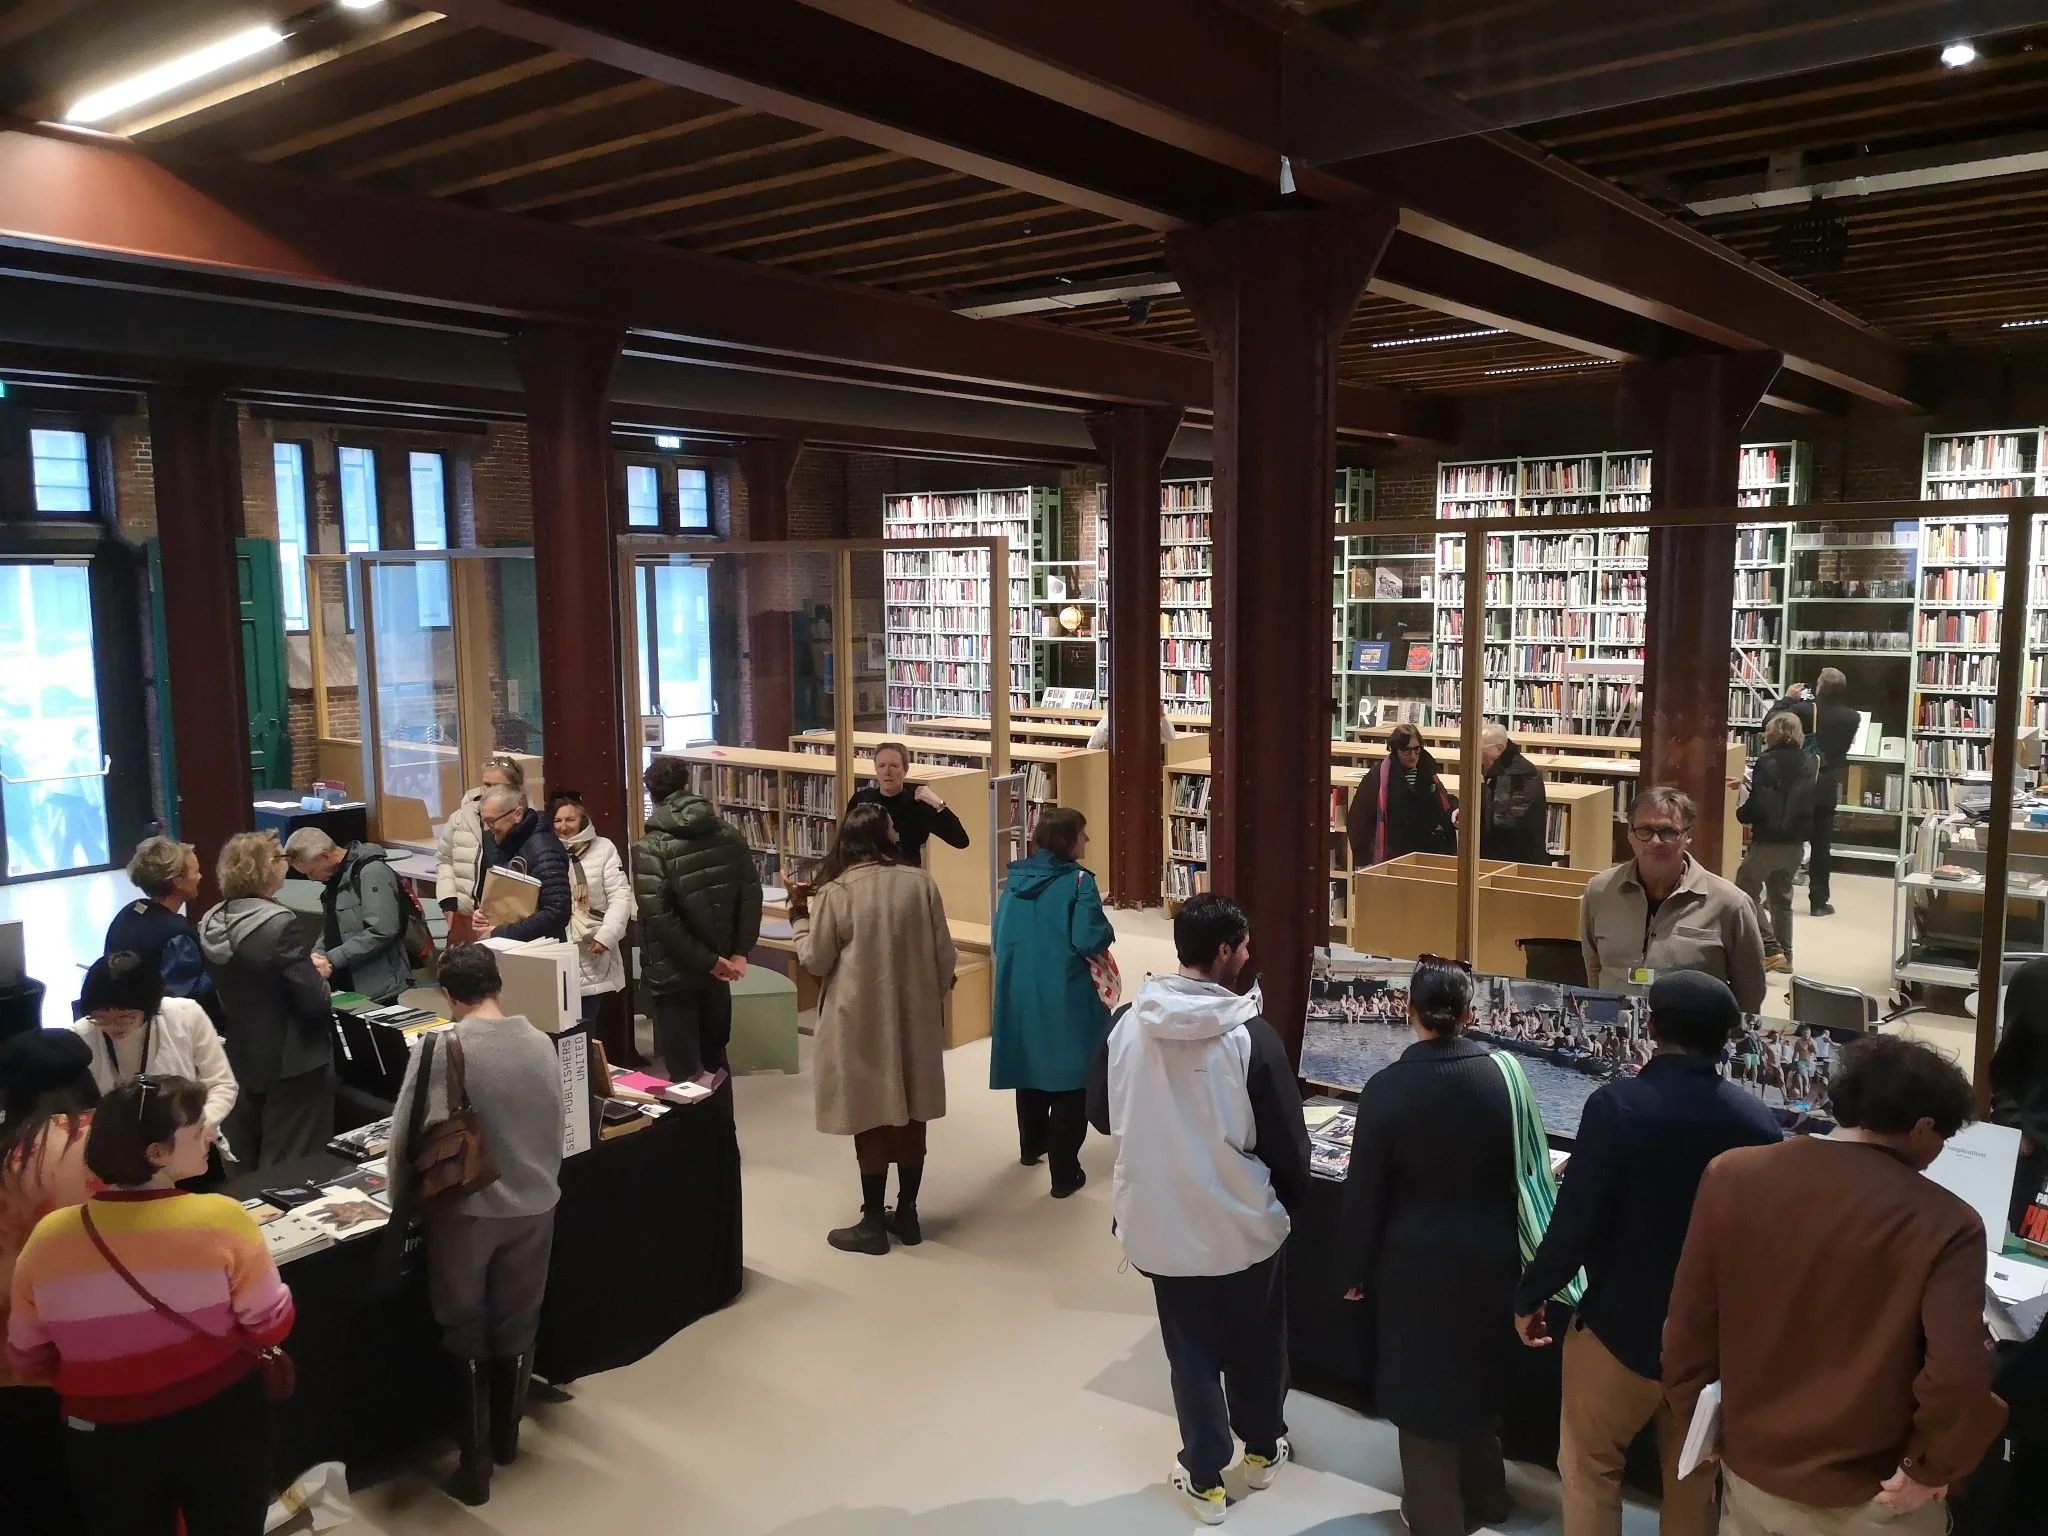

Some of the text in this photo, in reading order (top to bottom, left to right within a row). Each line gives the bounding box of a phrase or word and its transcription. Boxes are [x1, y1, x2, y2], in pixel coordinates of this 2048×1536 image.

[562, 1040, 575, 1152] SELF PUBLISHERS
[574, 1036, 585, 1082] UNITED
